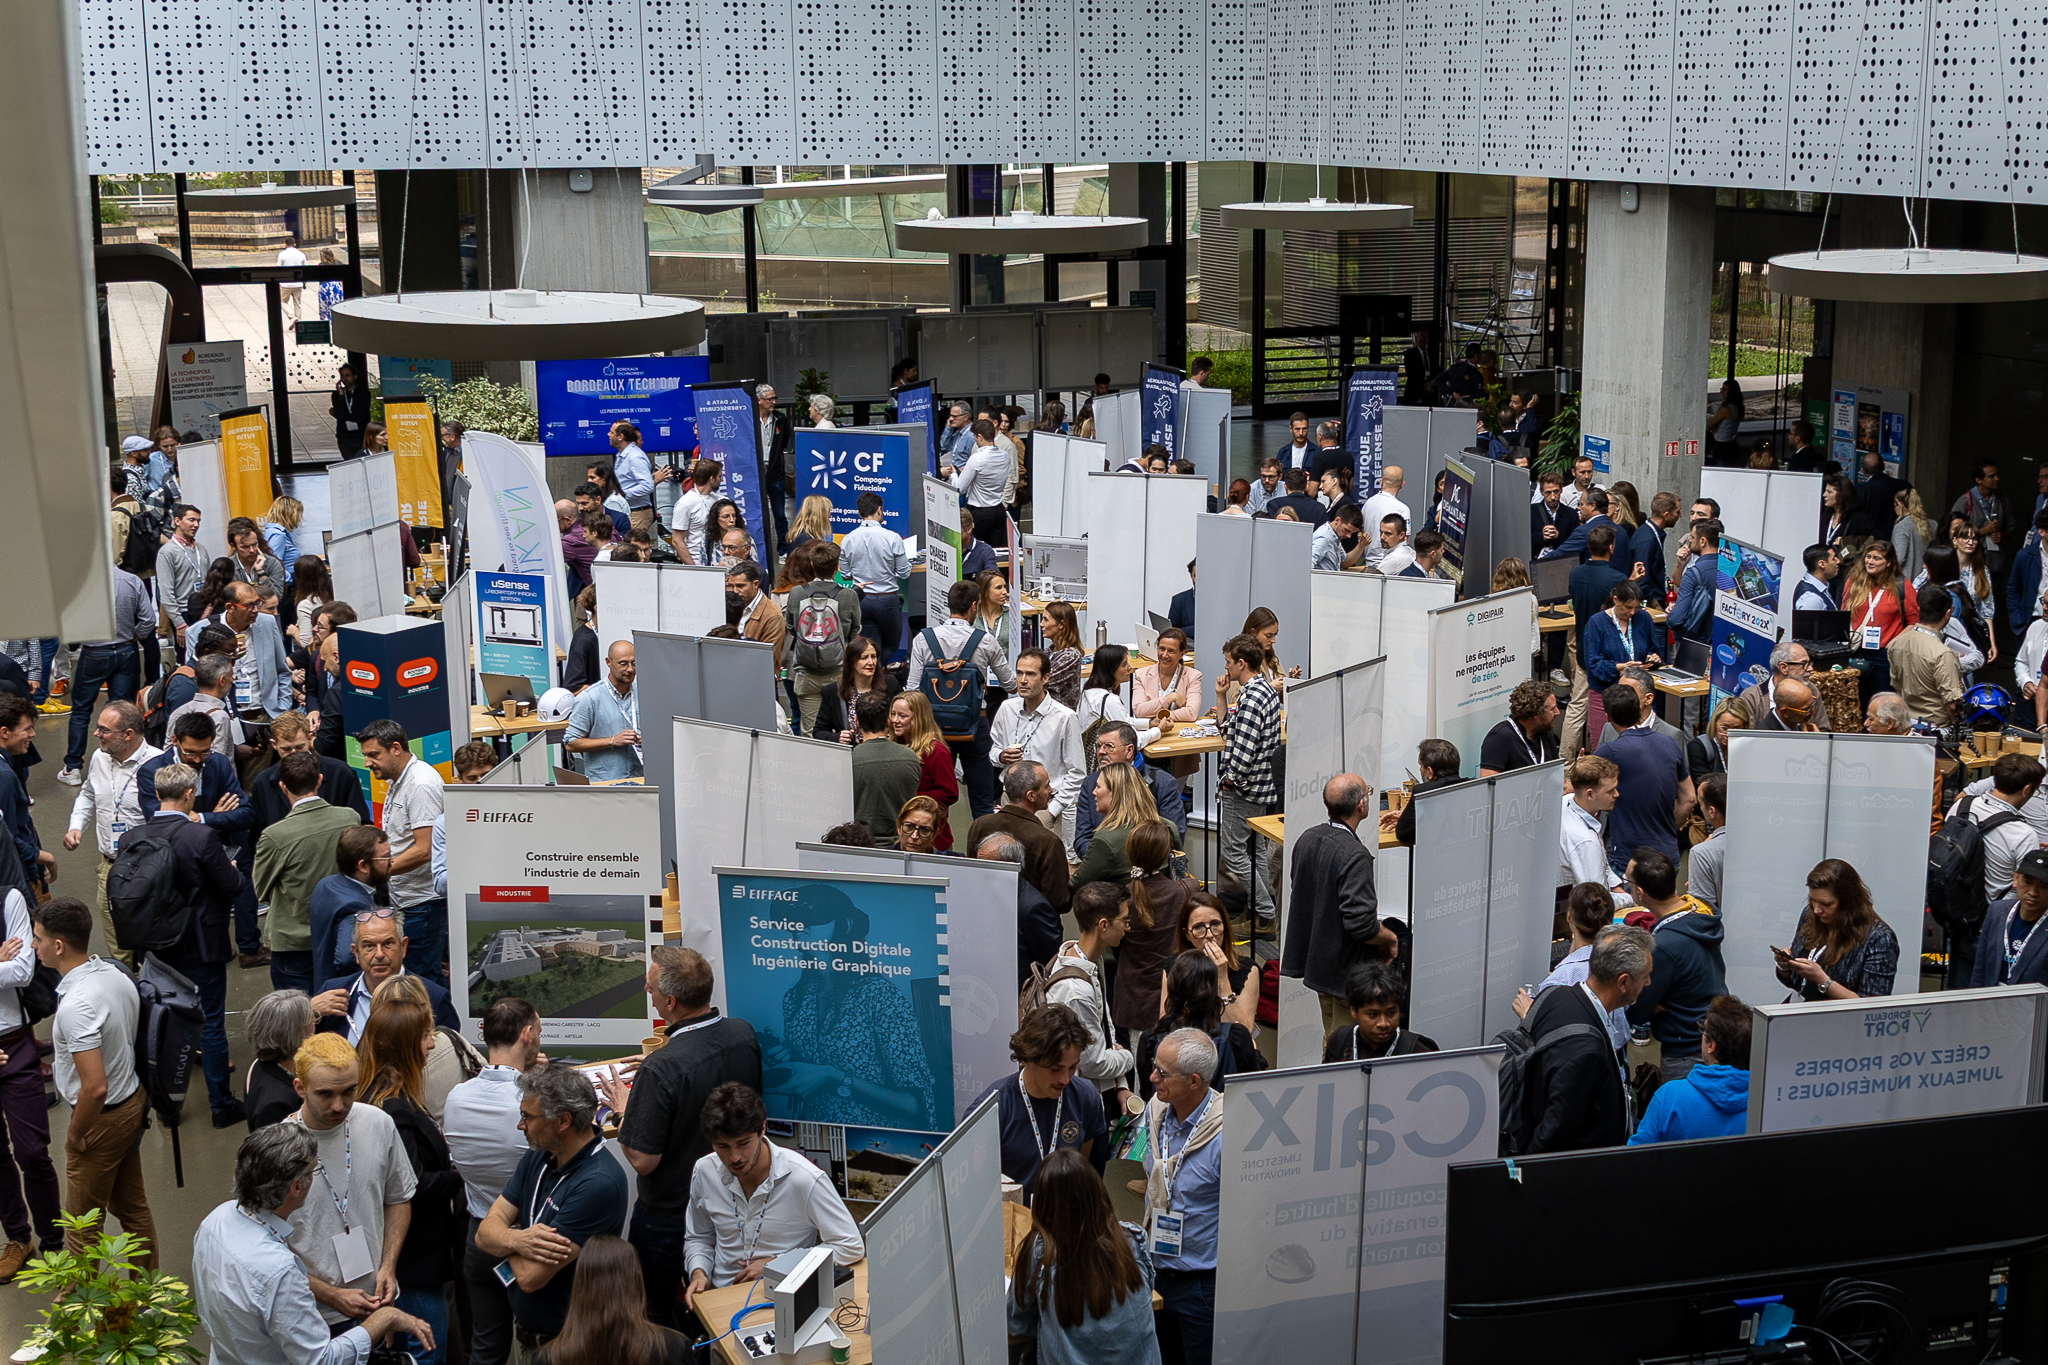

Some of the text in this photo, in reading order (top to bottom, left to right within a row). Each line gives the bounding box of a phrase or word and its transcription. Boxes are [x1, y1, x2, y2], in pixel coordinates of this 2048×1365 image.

[566, 378, 625, 392] BORDEAUX
[853, 451, 885, 473] CF
[853, 475, 893, 485] Compagnie
[853, 483, 887, 493] Fiduciaire
[491, 579, 530, 590] uSense
[1477, 607, 1504, 622] DIGIPAIR
[1465, 645, 1506, 664] Les équipes
[1455, 654, 1516, 678] ne repartent plus
[1471, 670, 1500, 684] de zéro.
[483, 812, 534, 823] EIFFAGE
[526, 852, 640, 863] Construire ensemble
[524, 867, 640, 879] l'industrie de demain
[749, 889, 799, 902] EIFFAGE
[749, 916, 805, 932] Service
[750, 934, 912, 958] Construction Digitale
[752, 953, 912, 978] Ingénierie Graphique
